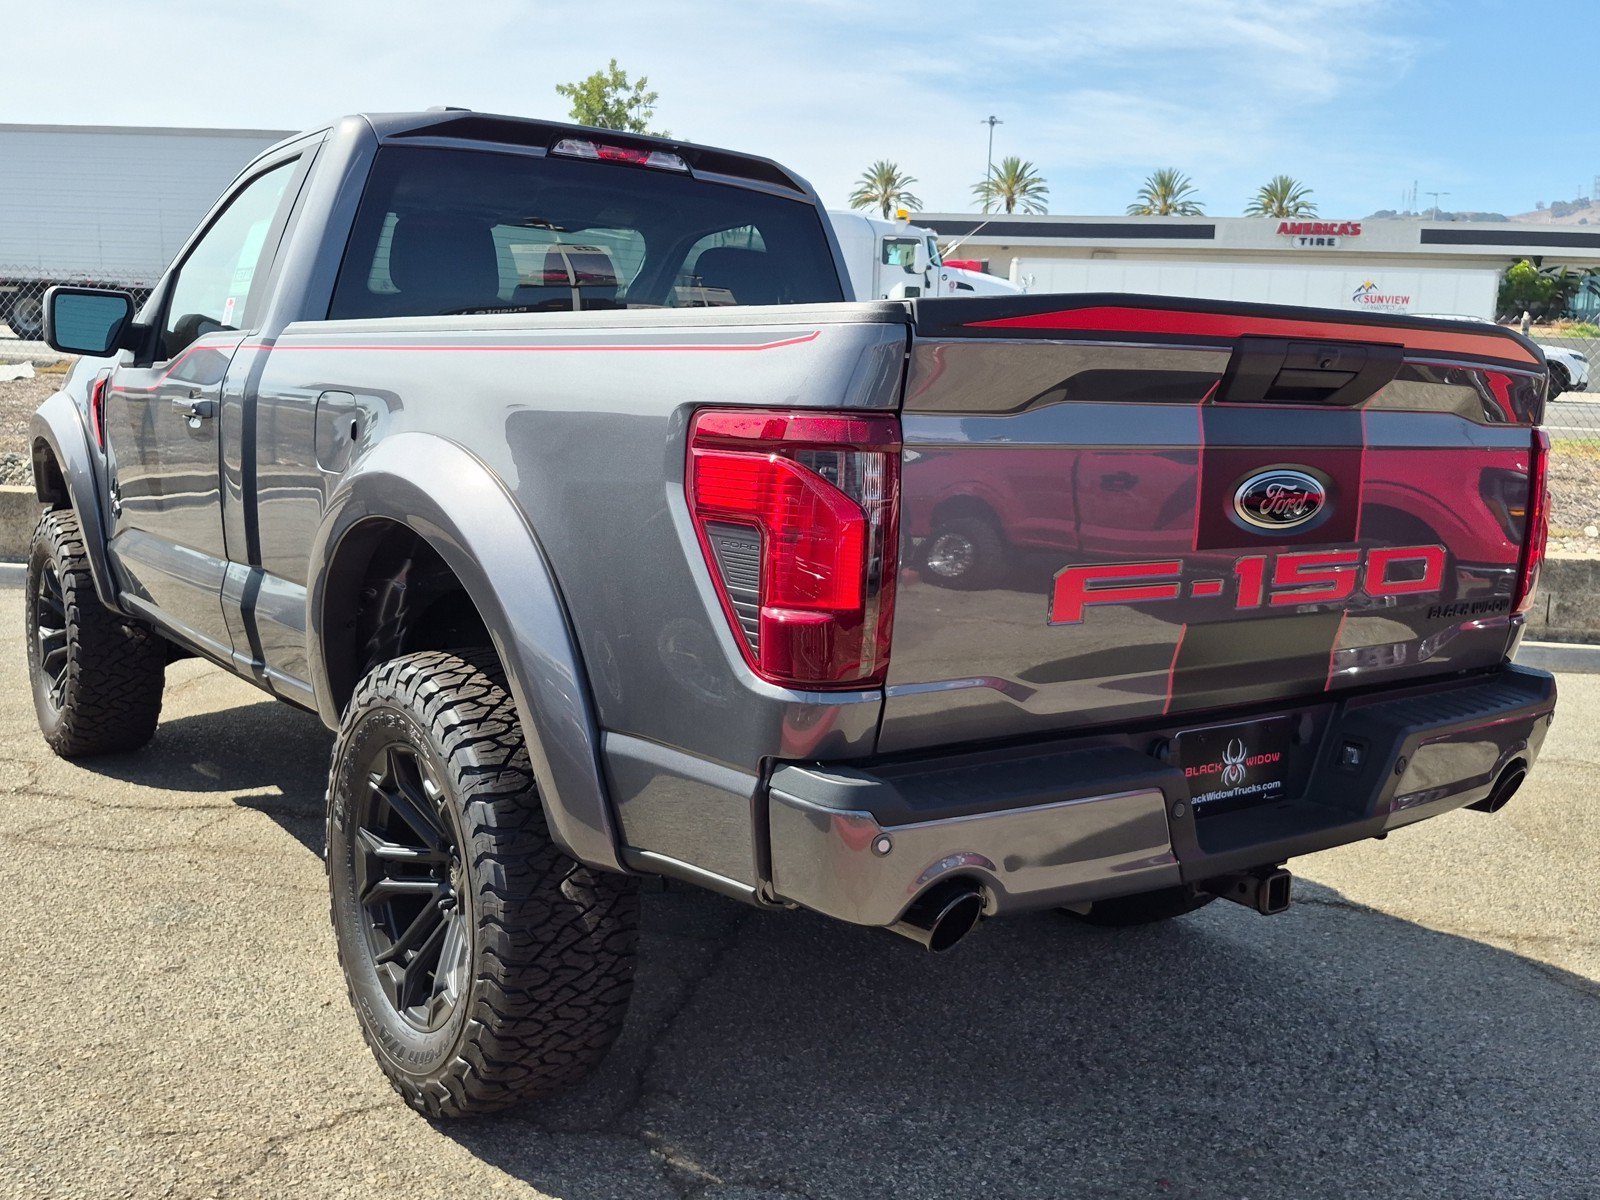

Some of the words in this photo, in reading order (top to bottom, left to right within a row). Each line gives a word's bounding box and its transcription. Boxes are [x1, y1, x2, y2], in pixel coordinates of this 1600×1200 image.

[1276, 221, 1362, 236] AMERICA'S
[1299, 237, 1336, 247] TIRE
[1363, 295, 1410, 305] SUNVIEW
[1259, 482, 1310, 518] Ford
[720, 540, 760, 552] FORD
[1047, 543, 1448, 626] F-150
[1185, 762, 1223, 777] BLACK
[1245, 752, 1280, 767] WIDOW
[1191, 780, 1281, 805] ackWidowTrucks.com
